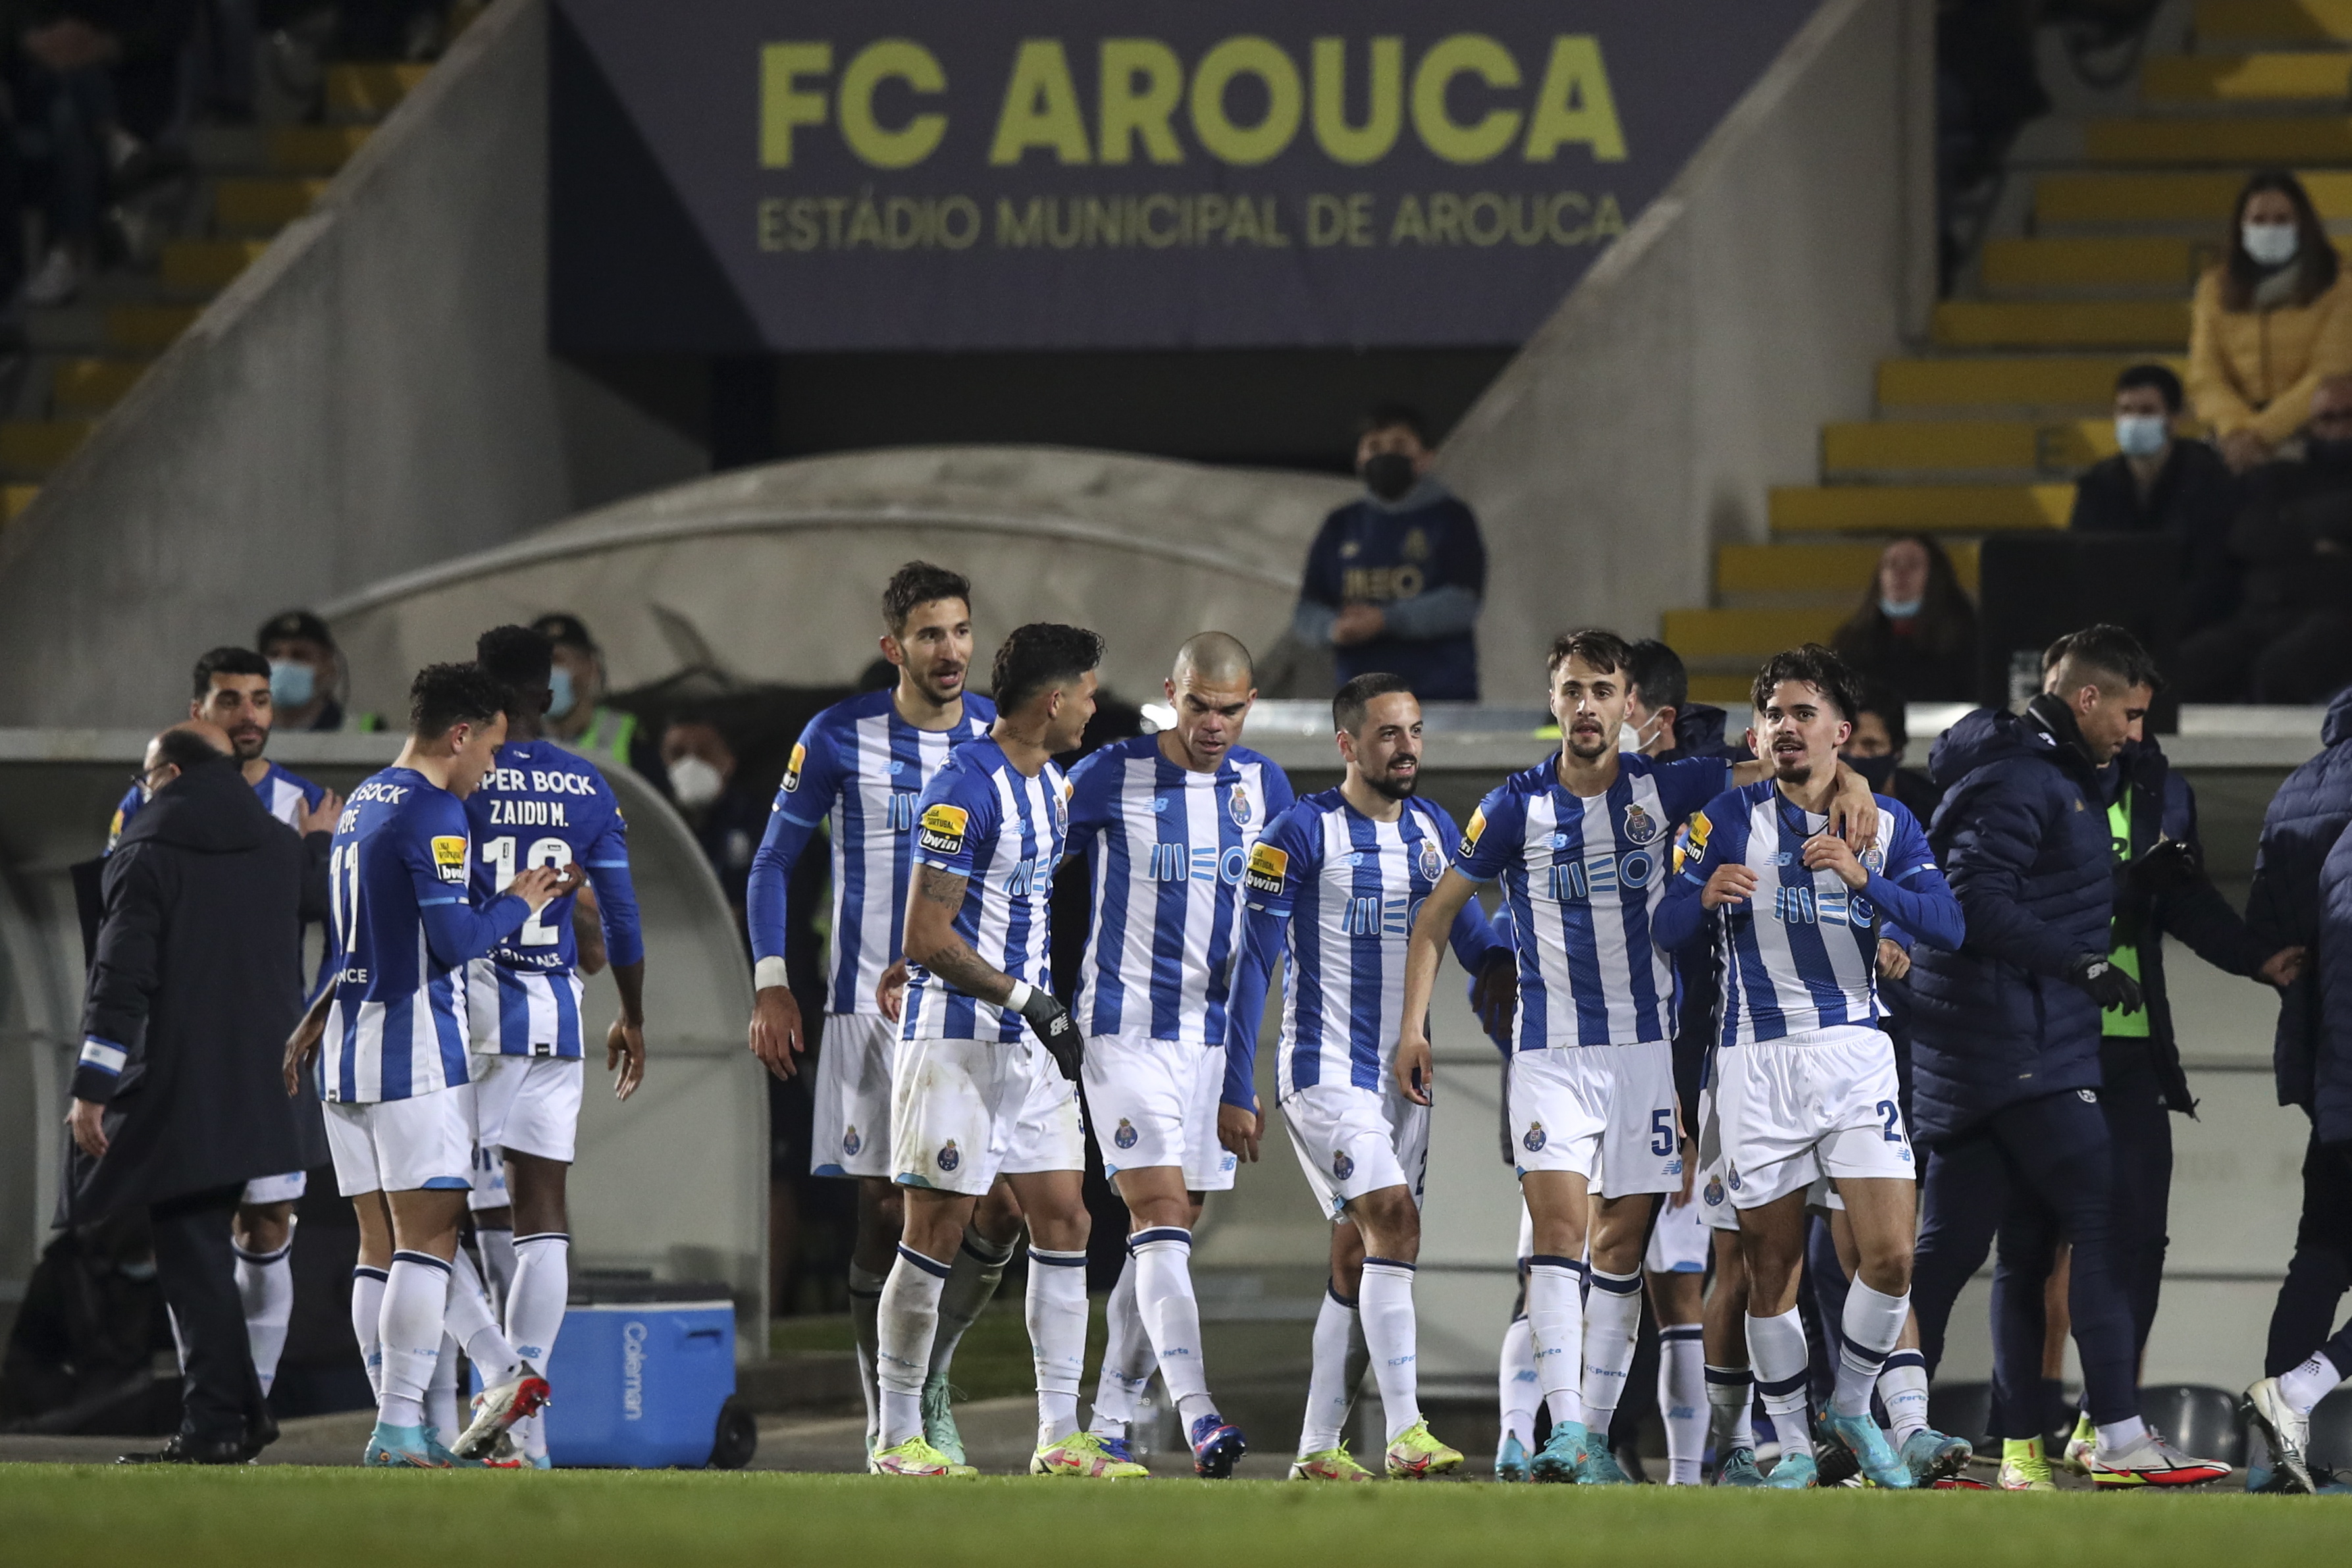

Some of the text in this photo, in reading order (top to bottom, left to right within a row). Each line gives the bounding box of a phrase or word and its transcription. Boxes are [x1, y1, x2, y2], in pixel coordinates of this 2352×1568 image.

[759, 33, 1630, 170] FC AROUCA
[757, 182, 1629, 252] ESTÁDIO MUNICIPAL DE AROUCA
[357, 783, 409, 804] BOCK
[475, 768, 597, 796] PER BOCK
[490, 799, 569, 827] ZAIDU M.
[922, 829, 958, 851] bwin
[1148, 843, 1247, 886] MEO
[1247, 870, 1281, 893] bwin
[1548, 849, 1654, 900] MEO
[330, 841, 359, 956] 11
[623, 1320, 648, 1421] Coleman
